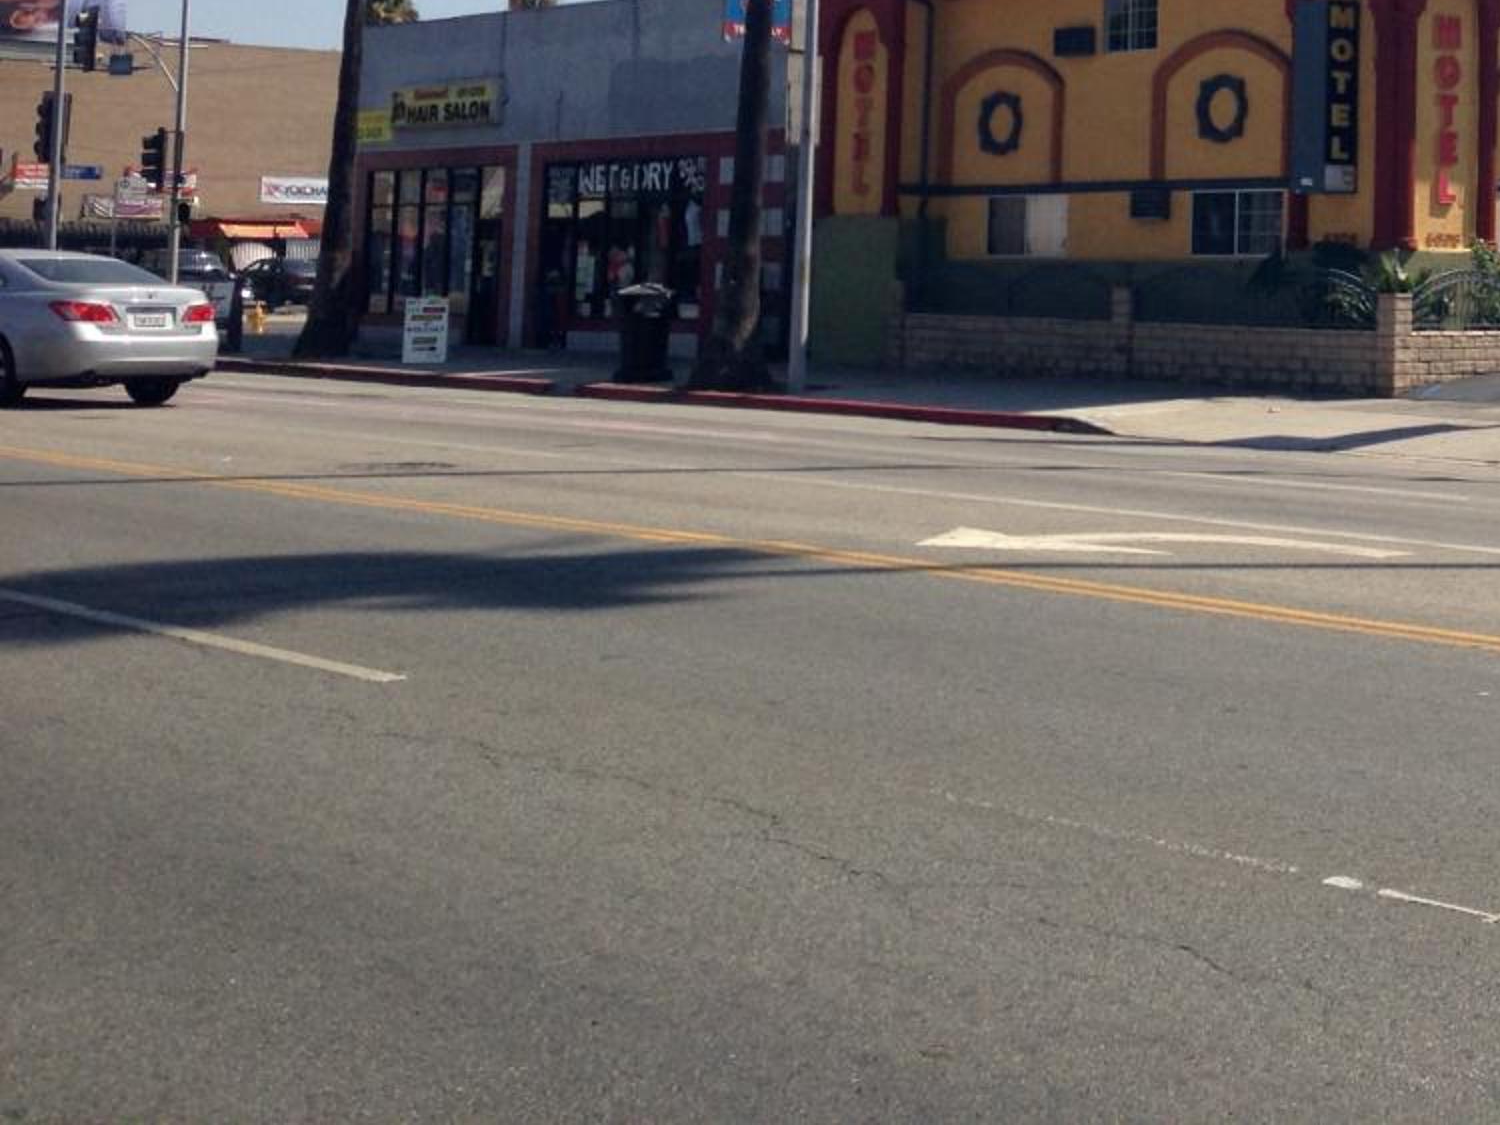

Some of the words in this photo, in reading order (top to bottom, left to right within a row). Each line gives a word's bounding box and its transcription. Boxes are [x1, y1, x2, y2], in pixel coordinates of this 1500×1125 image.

[407, 103, 439, 123] HAIR
[443, 100, 490, 123] SALON
[1330, 5, 1355, 161] MOTEL
[1432, 13, 1462, 206] MOTEL
